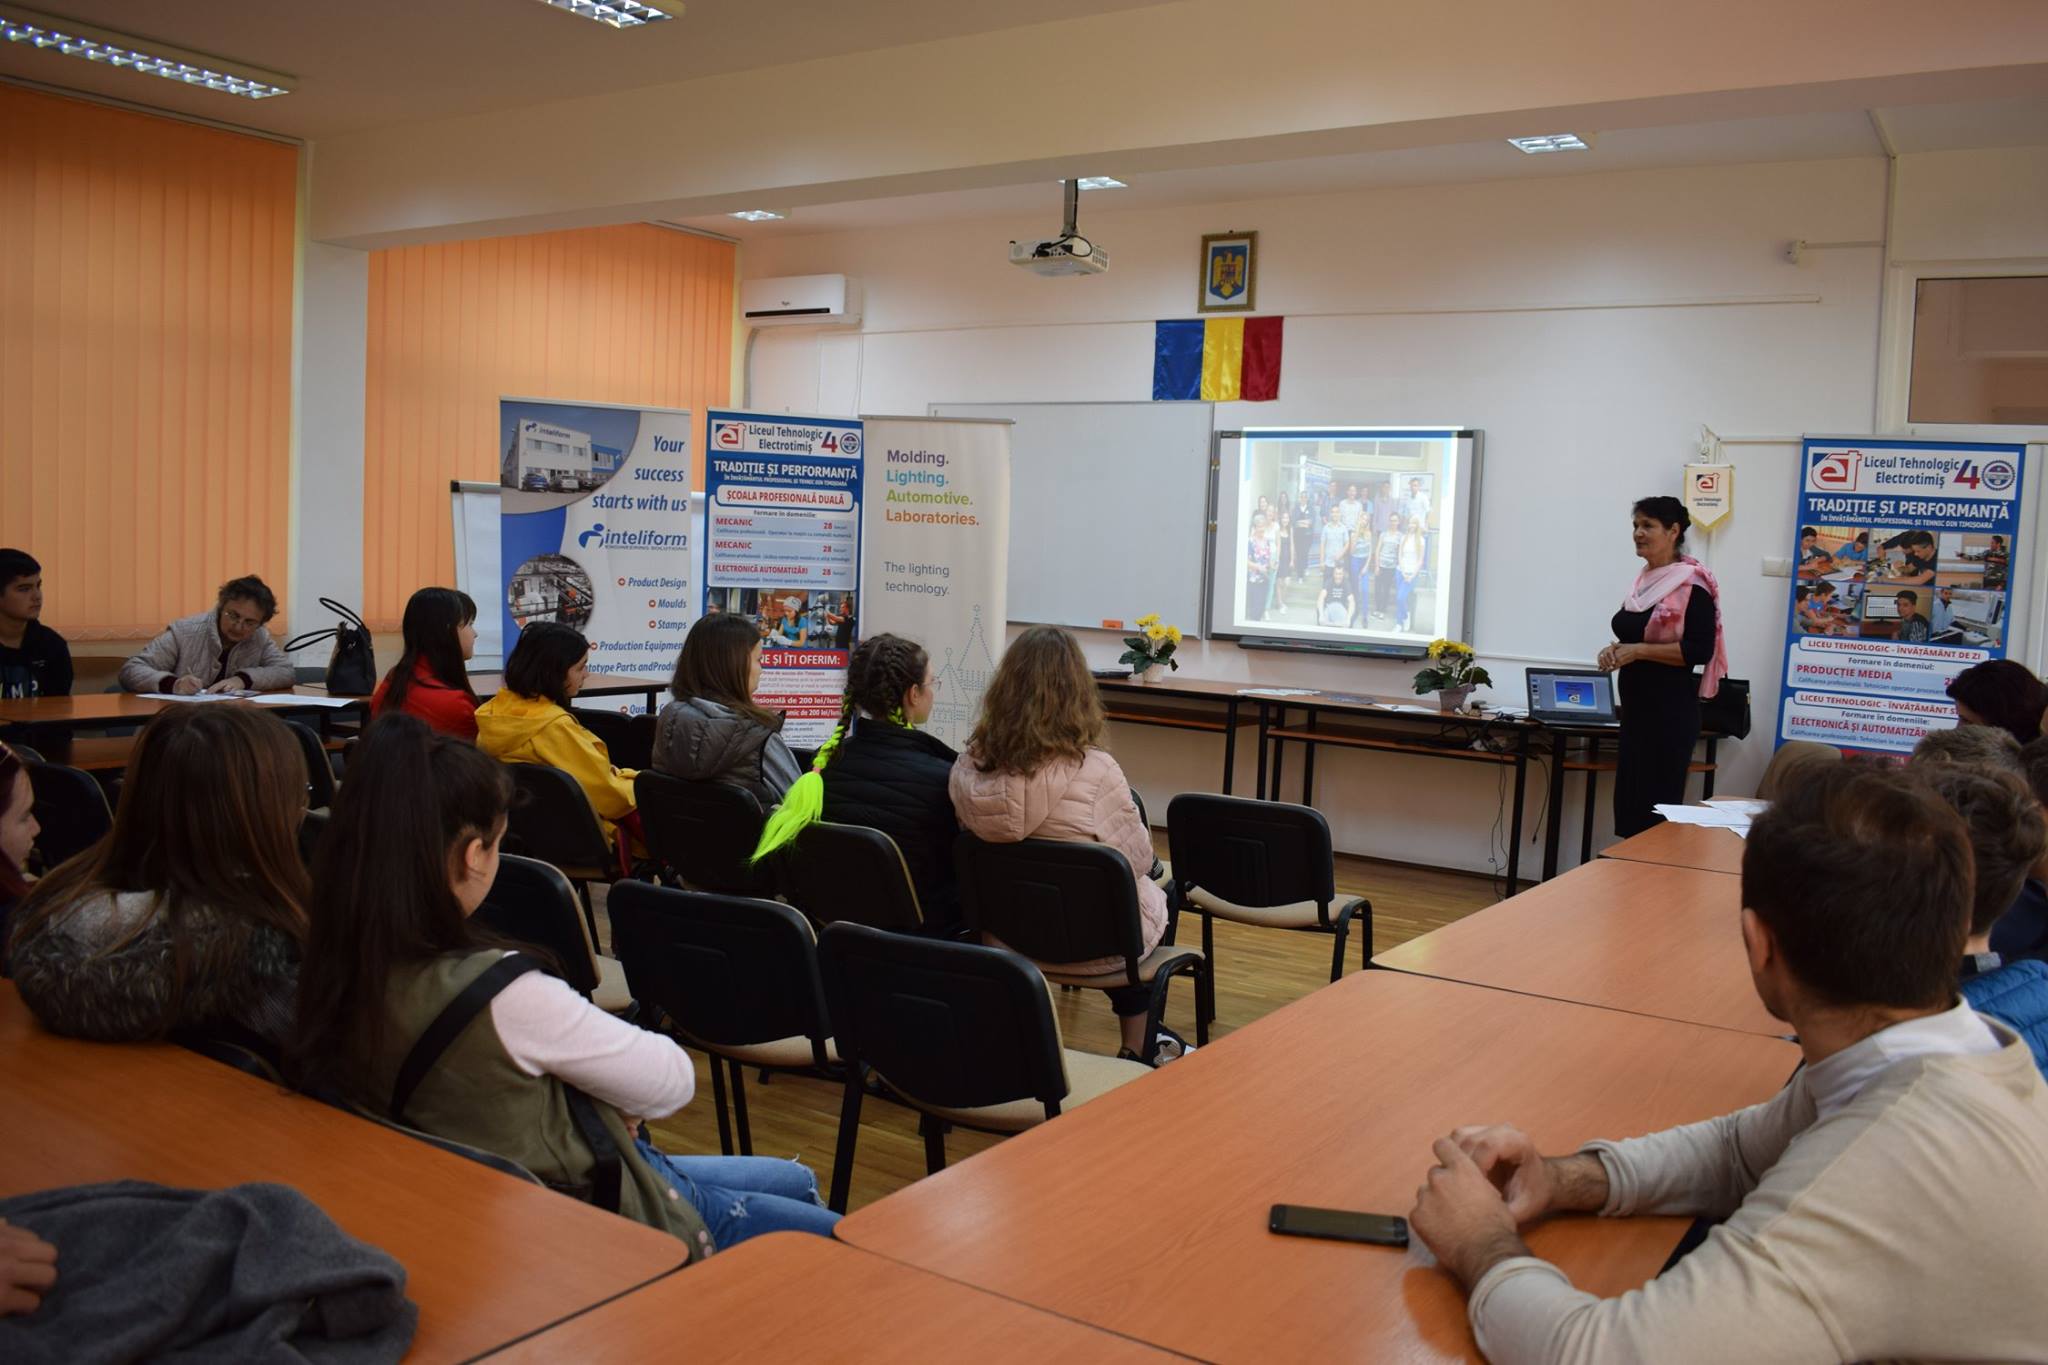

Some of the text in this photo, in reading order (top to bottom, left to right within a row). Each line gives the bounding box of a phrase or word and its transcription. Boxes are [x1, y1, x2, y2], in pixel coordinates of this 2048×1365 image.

[749, 425, 774, 436] Liceul
[777, 427, 823, 441] Tehnologic
[654, 436, 684, 453] Your
[887, 449, 949, 467] Molding.
[1864, 456, 1897, 468] Liceul
[1900, 457, 1959, 473] Tehnologic
[634, 467, 683, 482] success
[886, 469, 949, 487] Lighting.
[592, 493, 687, 512] starts with us
[886, 489, 973, 506] Automotive.
[716, 518, 752, 527] MECANIC
[886, 509, 980, 526] Laboratories.
[605, 529, 687, 546] inteliform
[715, 541, 752, 550] MECANIC
[885, 561, 950, 578] The lighting
[628, 577, 687, 590] Product Design
[885, 581, 950, 597] technology.
[658, 599, 687, 609] Moulds
[658, 620, 687, 631] Stamps
[600, 641, 684, 652] Production Equipmen
[1808, 640, 1832, 649] LICEU
[1834, 642, 1889, 653] TEHNOLOGIC
[1959, 651, 1971, 659] DE
[1973, 652, 1981, 660] ZI
[800, 655, 840, 665] OFERIM:
[585, 663, 615, 674] totype
[616, 662, 637, 672] Parts
[1858, 669, 1893, 680] MEDIA
[1800, 694, 1823, 703] LICEU
[1826, 696, 1881, 708] TEHNOLOGIC
[1861, 723, 1927, 736] AUTOMATIZĂR
